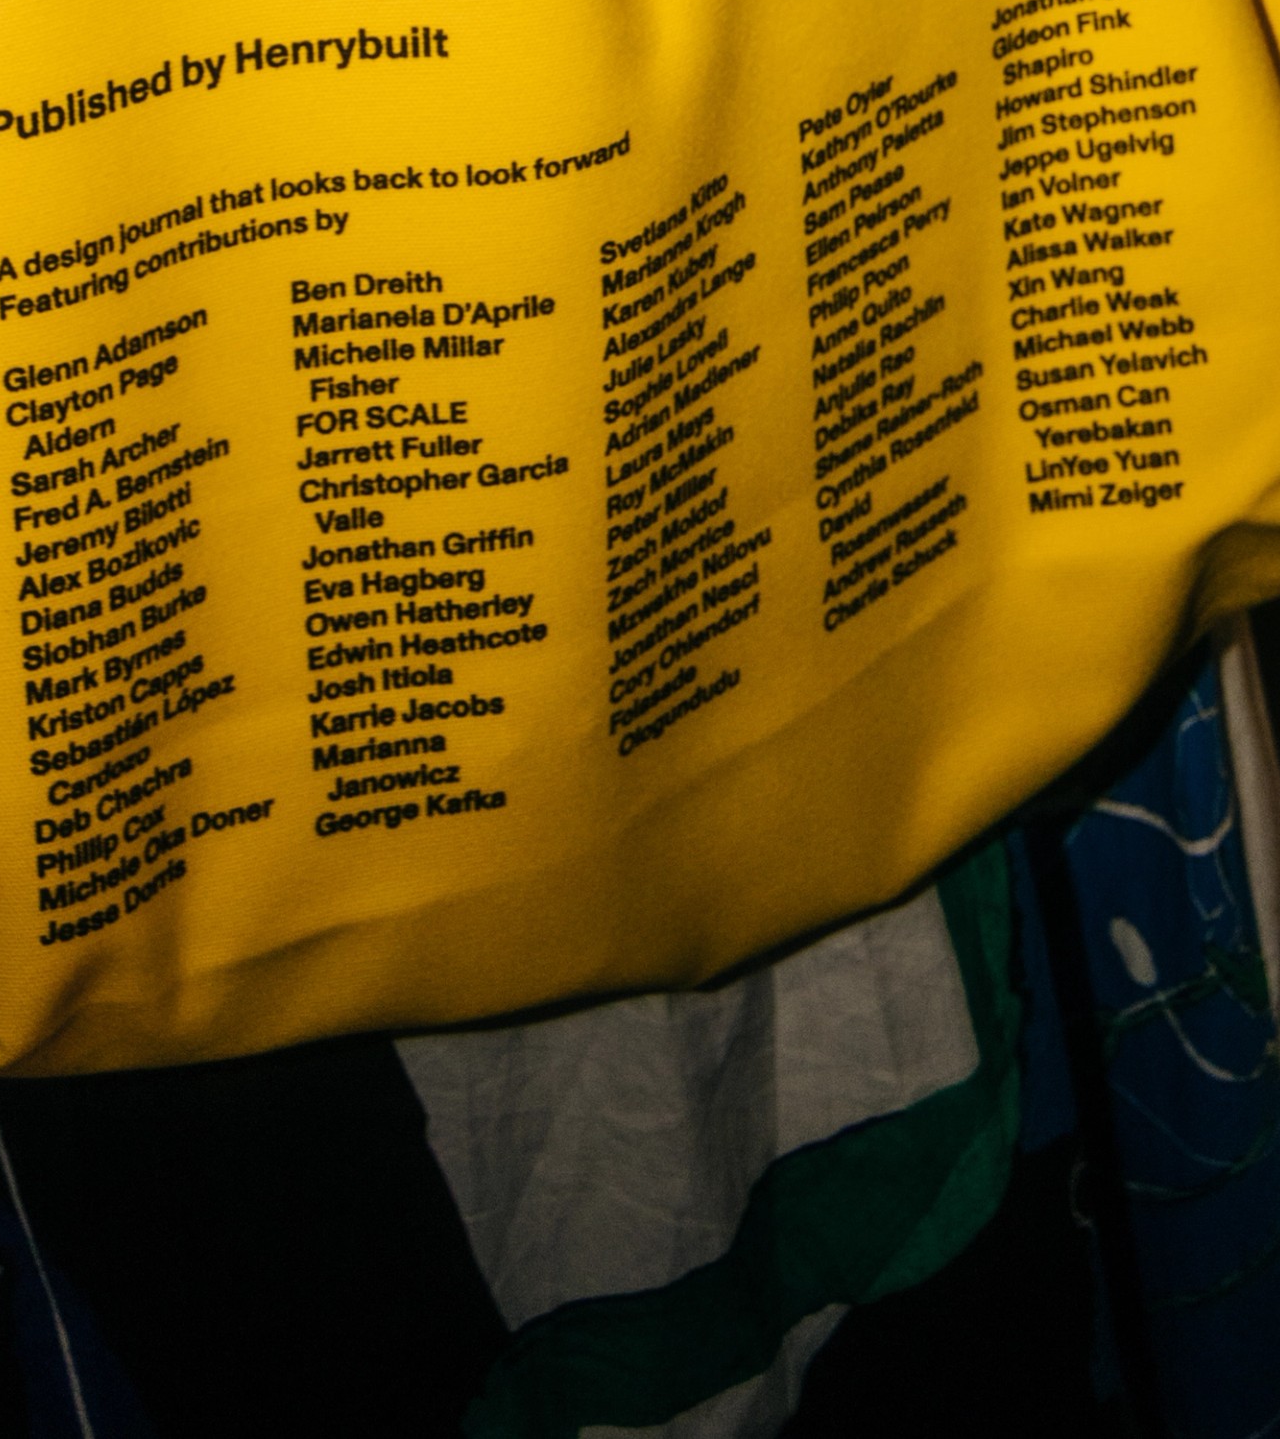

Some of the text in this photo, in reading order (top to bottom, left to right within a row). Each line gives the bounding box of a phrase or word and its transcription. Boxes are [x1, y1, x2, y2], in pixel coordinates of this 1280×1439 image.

[992, 9, 1130, 60] Gideon Fink
[182, 55, 226, 90] by
[236, 27, 448, 74] Henrybuilt
[1003, 49, 1093, 85] Shapiro
[996, 66, 1196, 120] Howard Shindler
[799, 108, 842, 142] Pete
[998, 100, 1196, 151] Jim Stephenson
[801, 121, 872, 174] Kathryn
[999, 132, 1174, 181] Jeppe Ugelvig
[803, 149, 878, 205] Anthony
[1002, 172, 1120, 210] Ian Volner
[24, 235, 114, 276] design
[119, 196, 203, 254] journal
[210, 183, 264, 214] that
[271, 172, 346, 201] looks
[354, 167, 423, 191] back
[429, 168, 458, 188] to
[466, 162, 526, 186] look
[533, 131, 630, 179] forward
[804, 200, 846, 235] Sam
[1004, 200, 1162, 241] Kate Wagner
[600, 206, 688, 264] Svetlana
[602, 191, 745, 297] Marianne Krogh
[805, 229, 850, 267] Ellen
[1007, 229, 1173, 270] Alissa Walker
[0, 209, 348, 320] Featuring contributions by
[1009, 266, 1124, 301] Xin Wang
[291, 271, 443, 304] Ben Dreith
[603, 253, 756, 361] Alexandra Lange
[603, 286, 665, 329] Karen
[1011, 288, 1179, 330] Charlie Weak
[293, 295, 555, 337] Marianela D'Aprile
[1014, 315, 1194, 360] Michael Webb
[3, 309, 207, 392] Glenn Adamson
[294, 335, 504, 370] Michelle Millar
[812, 319, 859, 359] Anne
[310, 375, 399, 402] Fisher
[603, 355, 654, 393] Julie
[1016, 345, 1207, 391] Susan Yelavich
[6, 356, 178, 427] Clayton Page
[604, 372, 674, 424] Sophie
[1019, 385, 1169, 421] Osman Can
[24, 418, 115, 460] Aldern
[297, 401, 467, 437] FOR SCALE
[605, 406, 670, 456] Adrian
[1035, 418, 1172, 448] Yerebakan
[11, 423, 180, 497] Sarah Archer
[297, 435, 483, 470] Jarrett Fuller
[606, 443, 663, 488] Laura
[1026, 450, 1179, 483] LinYee Yuan
[14, 438, 229, 531] Fred A. Bernstein
[299, 454, 569, 503] Christopher Garcia
[1029, 482, 1184, 513] Mimi Zeiger
[16, 481, 191, 567] Jeremy Bilotti
[315, 507, 384, 534] Valle
[606, 485, 646, 519] Roy
[19, 519, 200, 601] Alex Bozikovic
[302, 527, 534, 570] Jonathan Griffin
[607, 538, 657, 582] Zach
[21, 562, 183, 636] Diana Budds
[304, 568, 485, 604] Eva Hagberg
[607, 568, 657, 613] Zach
[23, 585, 207, 671] Siobhan Burke
[305, 594, 534, 637] Owen Hatherley
[25, 630, 186, 706] Mark Byrnes
[307, 623, 548, 671] Edwin Heathcote
[28, 655, 204, 741] Kriston Capps
[307, 663, 453, 703] Josh Itiola
[30, 674, 236, 776] Sebastián López
[310, 694, 505, 738] Karrie Jacobs
[312, 735, 446, 771] Marianna
[327, 764, 460, 802] Janowicz
[34, 808, 91, 844] Deb
[123, 804, 166, 843] Cox
[314, 789, 507, 838] George Kafka
[39, 799, 274, 912] Michele Oka Doner
[39, 904, 120, 946] Jesse
